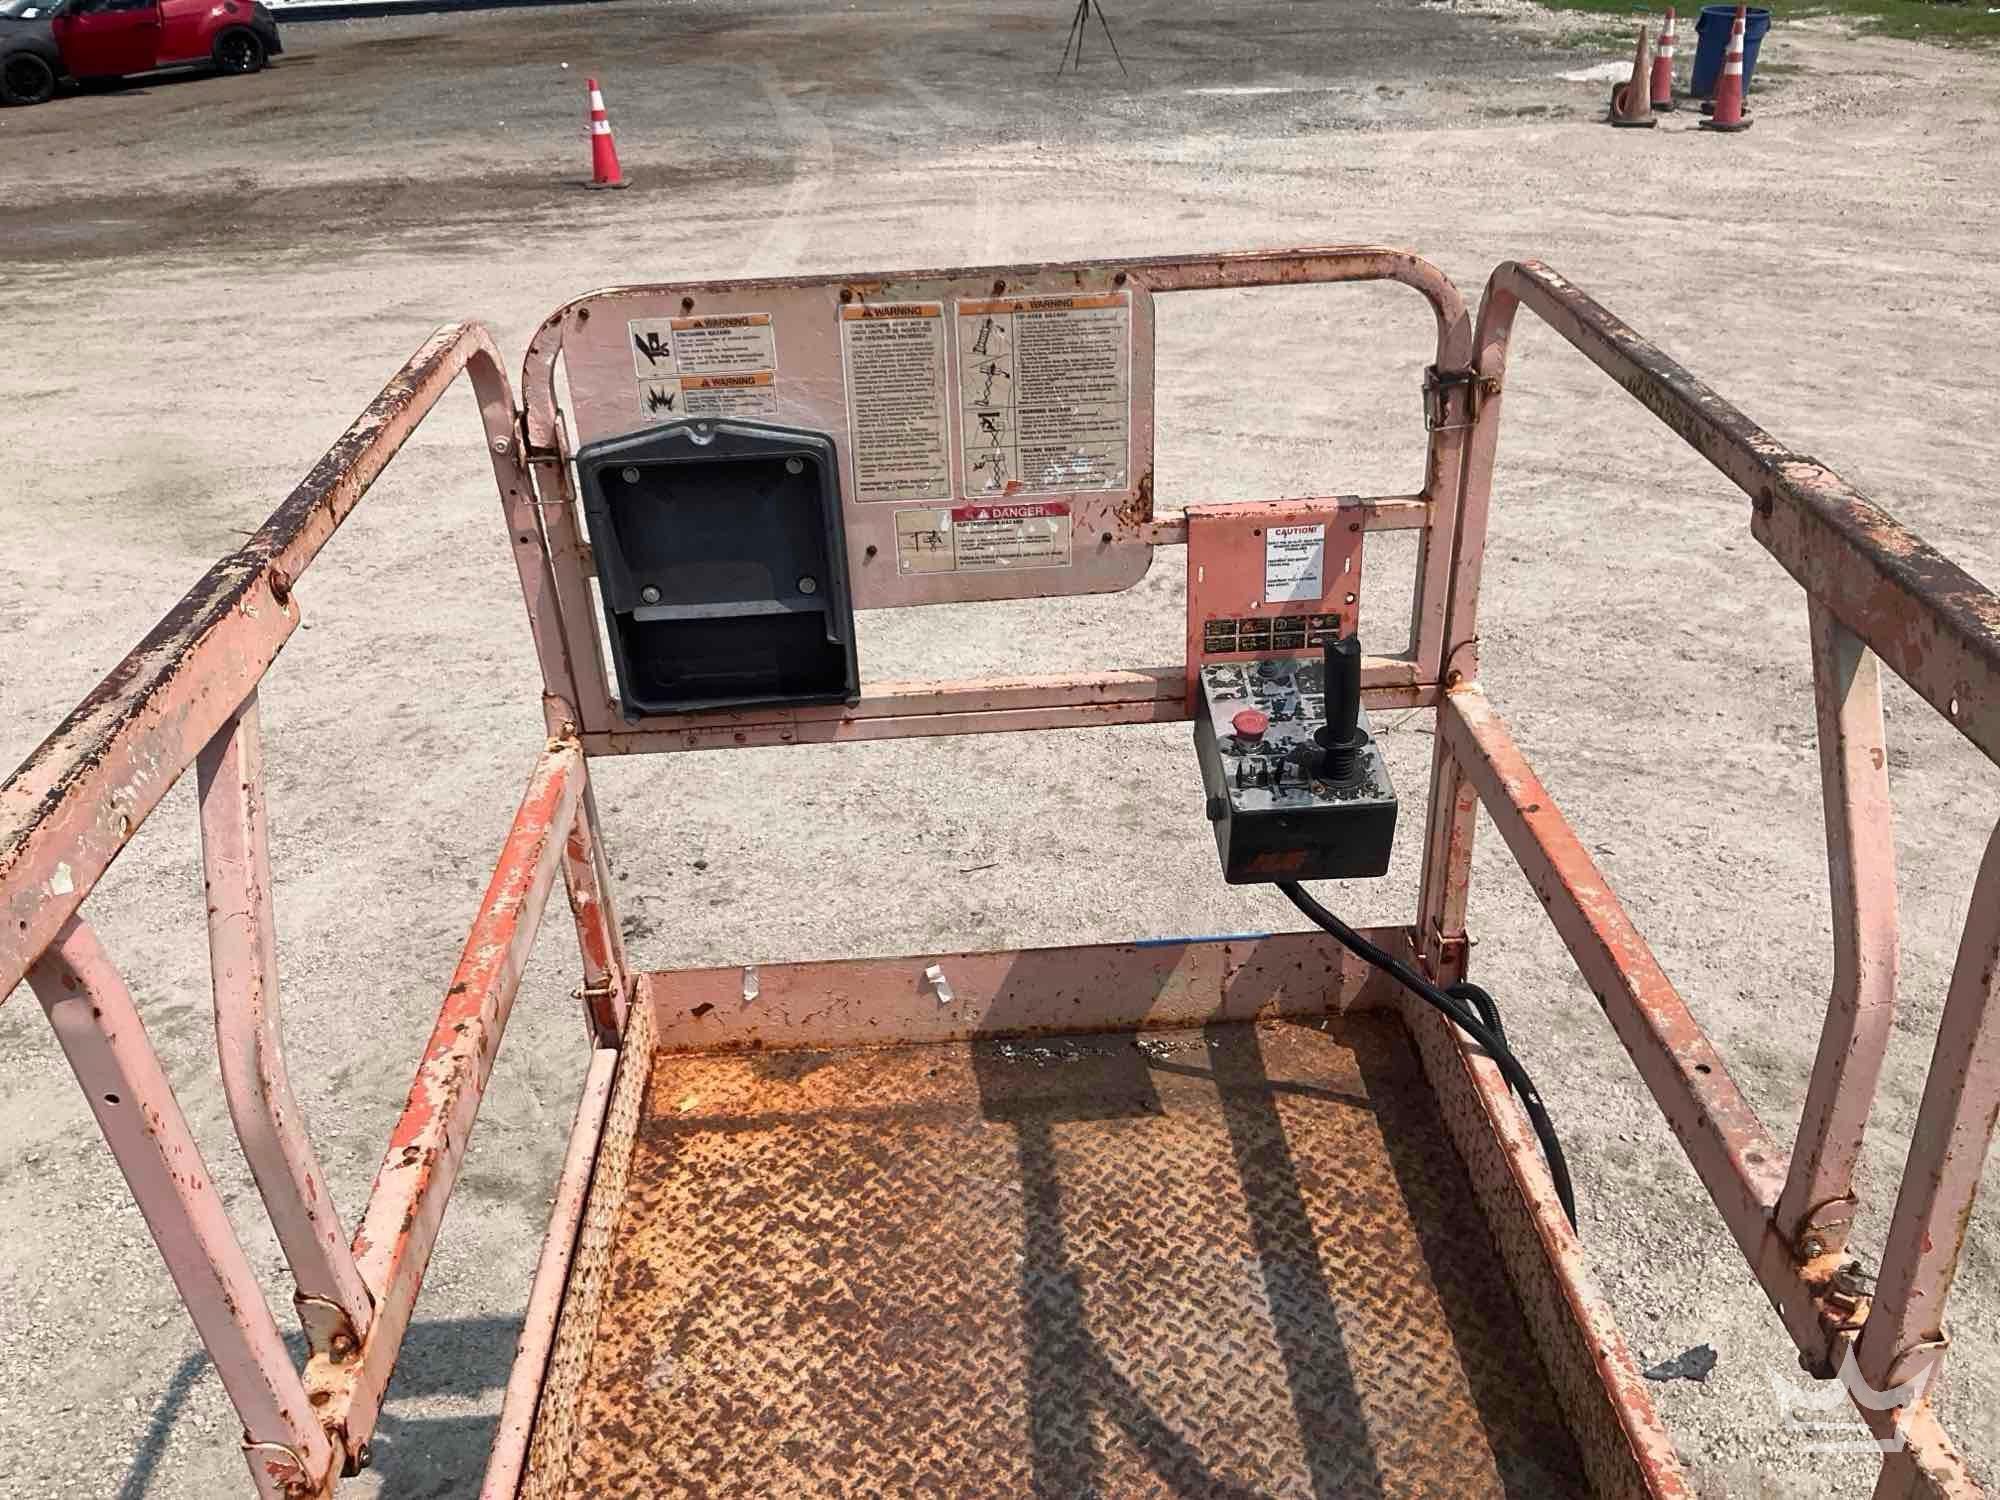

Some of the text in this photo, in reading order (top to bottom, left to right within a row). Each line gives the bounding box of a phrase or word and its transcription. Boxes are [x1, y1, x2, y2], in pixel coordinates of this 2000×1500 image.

[1030, 298, 1073, 309] WARNING
[874, 305, 922, 316] WARNING
[711, 375, 756, 387] WARNING
[992, 506, 1044, 518] DANGER
[1275, 526, 1317, 536] CAUTION!
